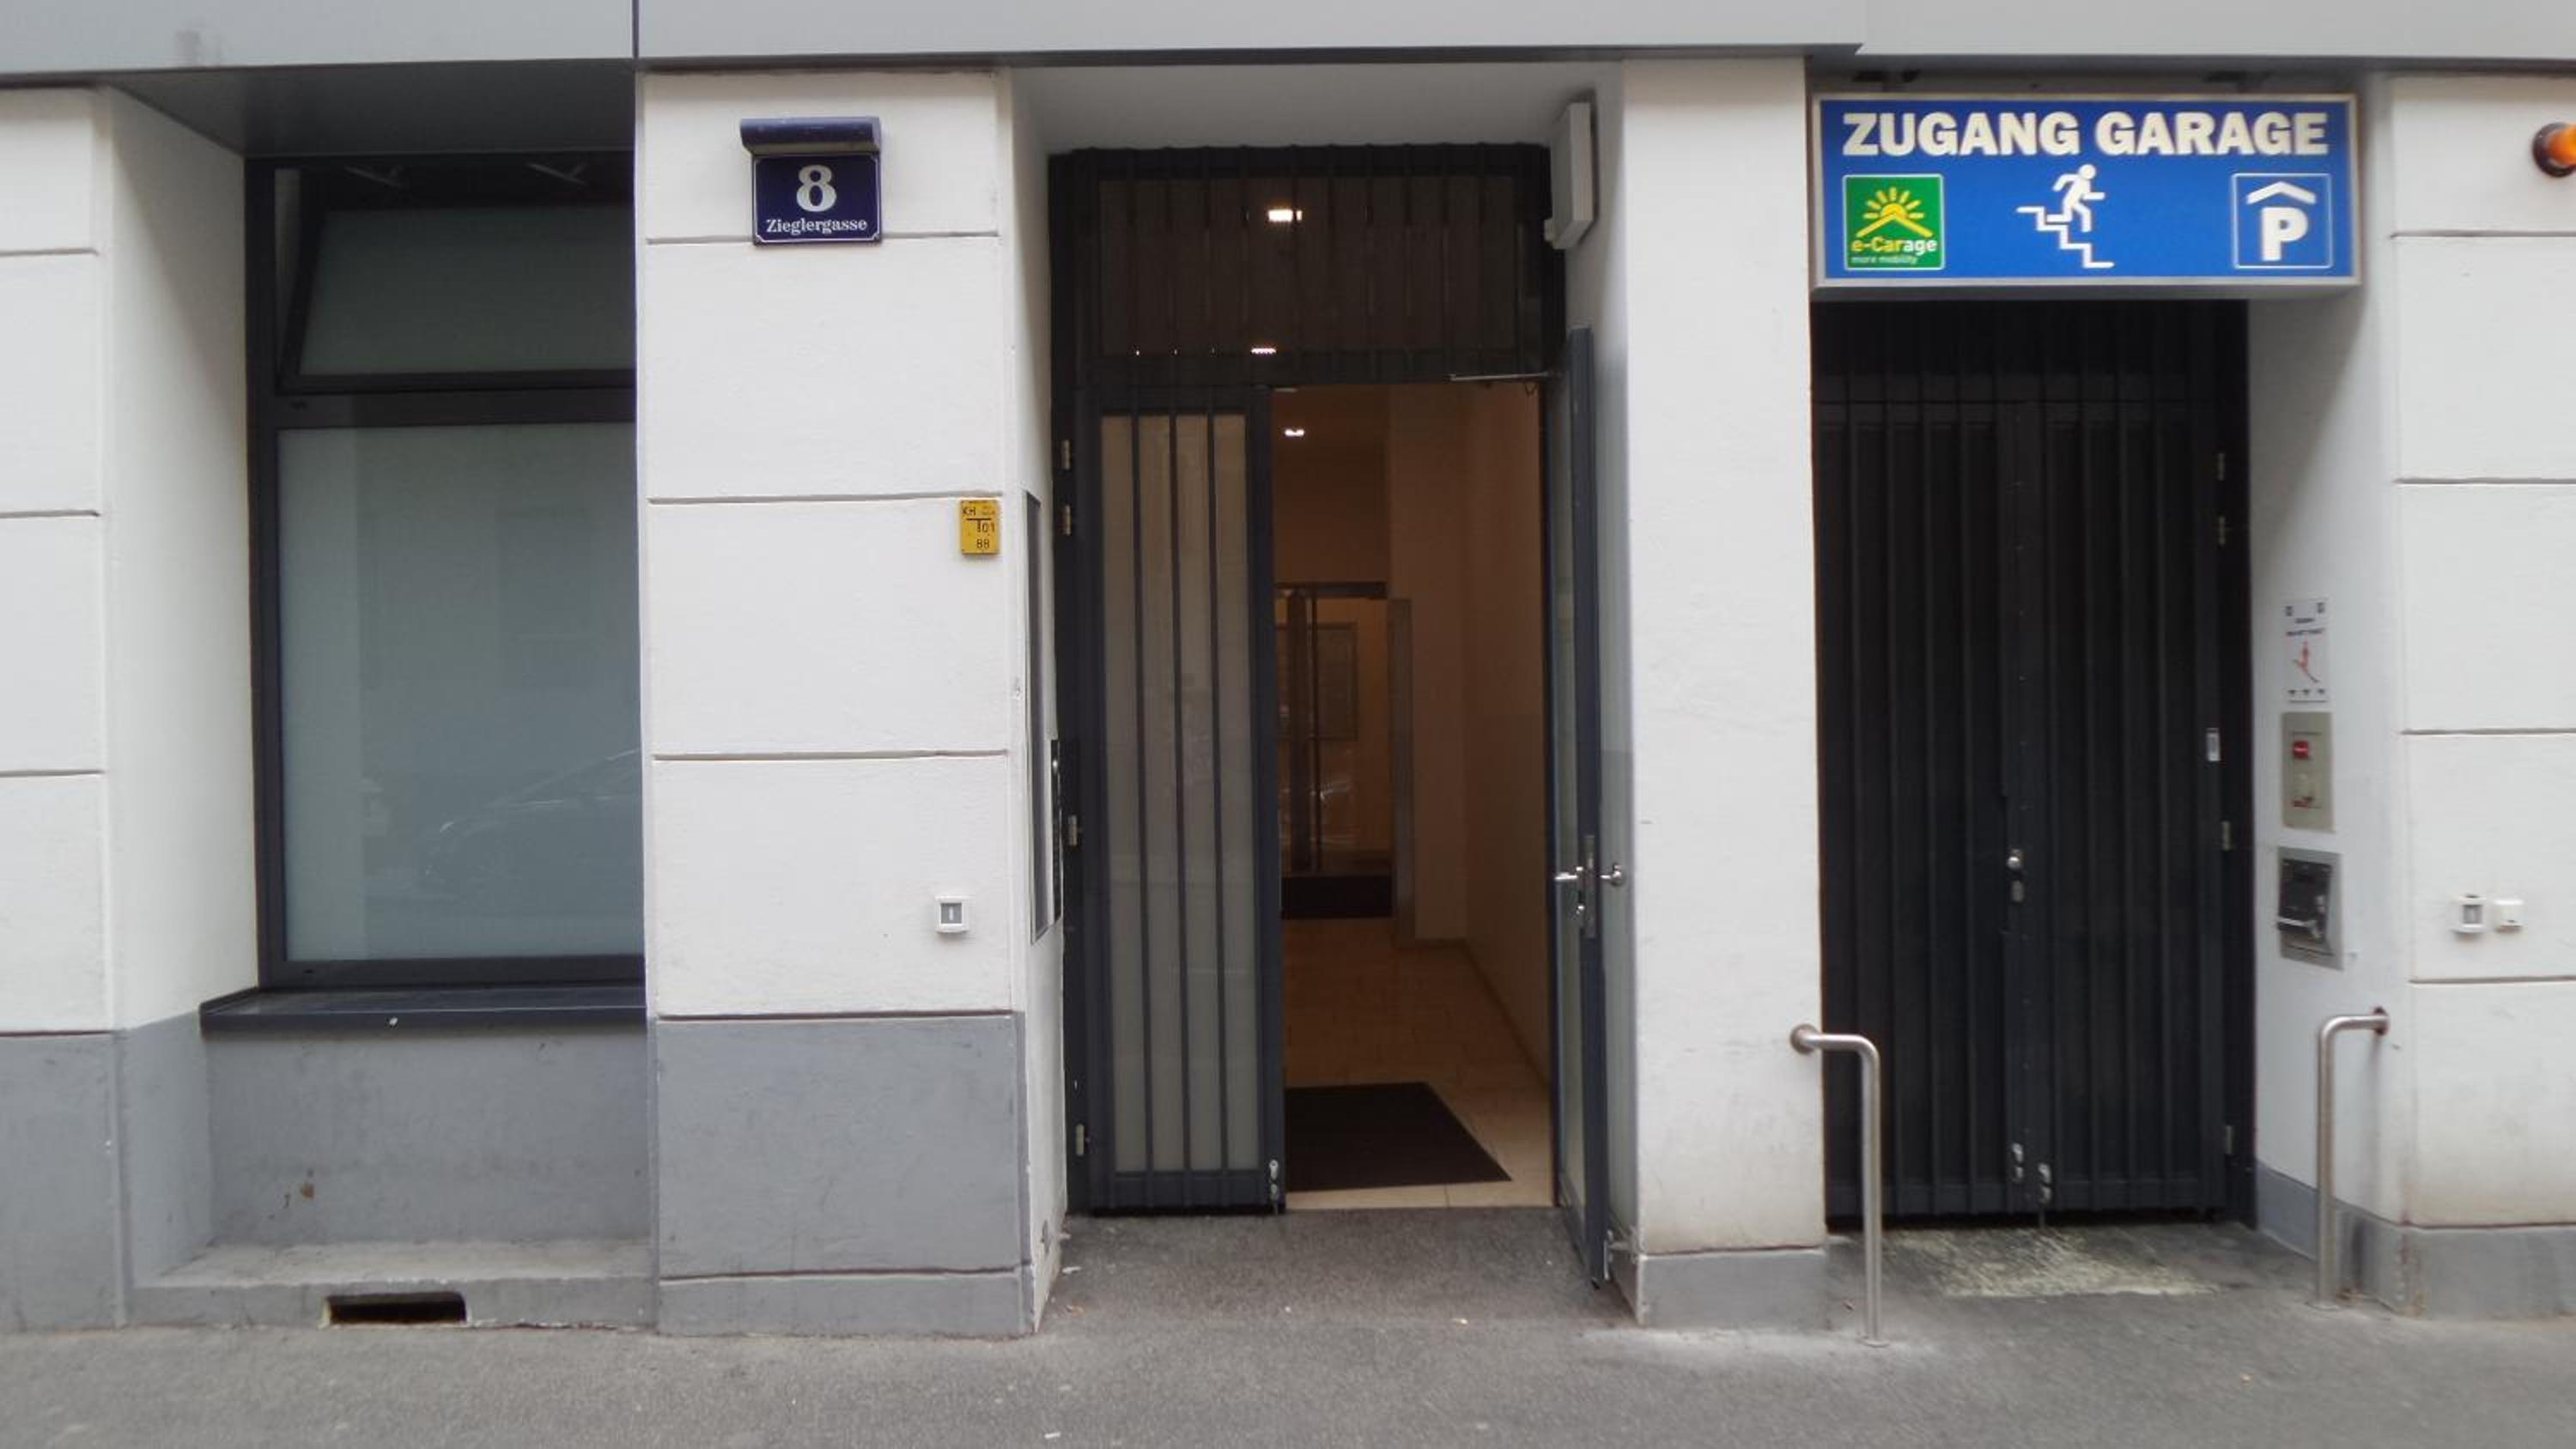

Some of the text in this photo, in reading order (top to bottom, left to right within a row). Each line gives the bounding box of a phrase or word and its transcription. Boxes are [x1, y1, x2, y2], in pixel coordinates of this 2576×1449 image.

[1843, 112, 2329, 156] ZUGANG GARAGE
[796, 165, 837, 212] 8
[766, 217, 868, 236] Zieglergasse
[1850, 236, 1937, 256] e-Carage
[2262, 206, 2309, 261] P
